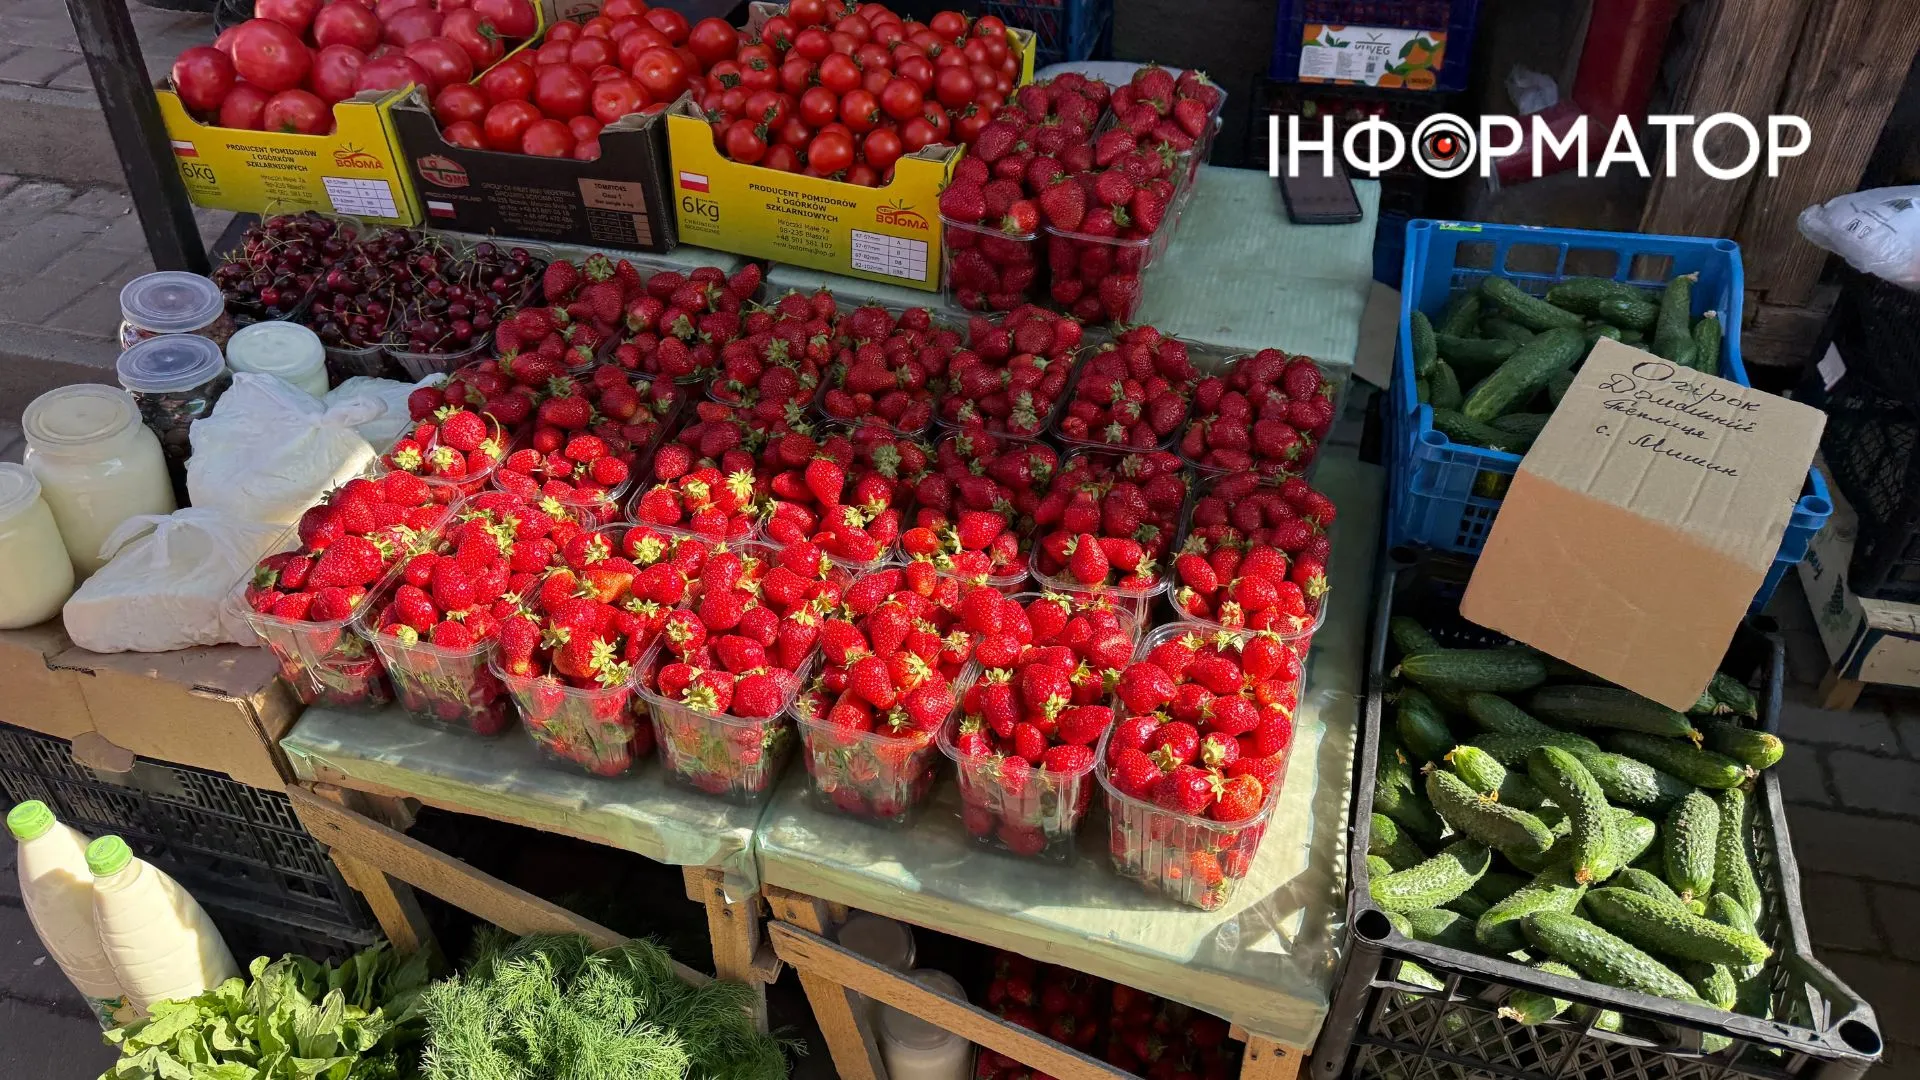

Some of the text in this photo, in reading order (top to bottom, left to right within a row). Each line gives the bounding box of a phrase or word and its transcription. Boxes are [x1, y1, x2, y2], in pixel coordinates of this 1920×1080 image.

[225, 143, 317, 157] PRODUCENT POMIDORÓW
[257, 154, 295, 163] OGÓRKÓW
[182, 162, 216, 184] 6kg
[246, 160, 308, 172] SZKLARNIOWYCH
[749, 183, 857, 208] PRODUCENT POMIDORÓW
[682, 196, 720, 222] 6kg
[765, 203, 839, 222] SZKLARNIOWYCH
[783, 198, 827, 212] OGÓRKÓW
[876, 212, 929, 230] BOTOMA
[1632, 362, 1760, 411] Огірок
